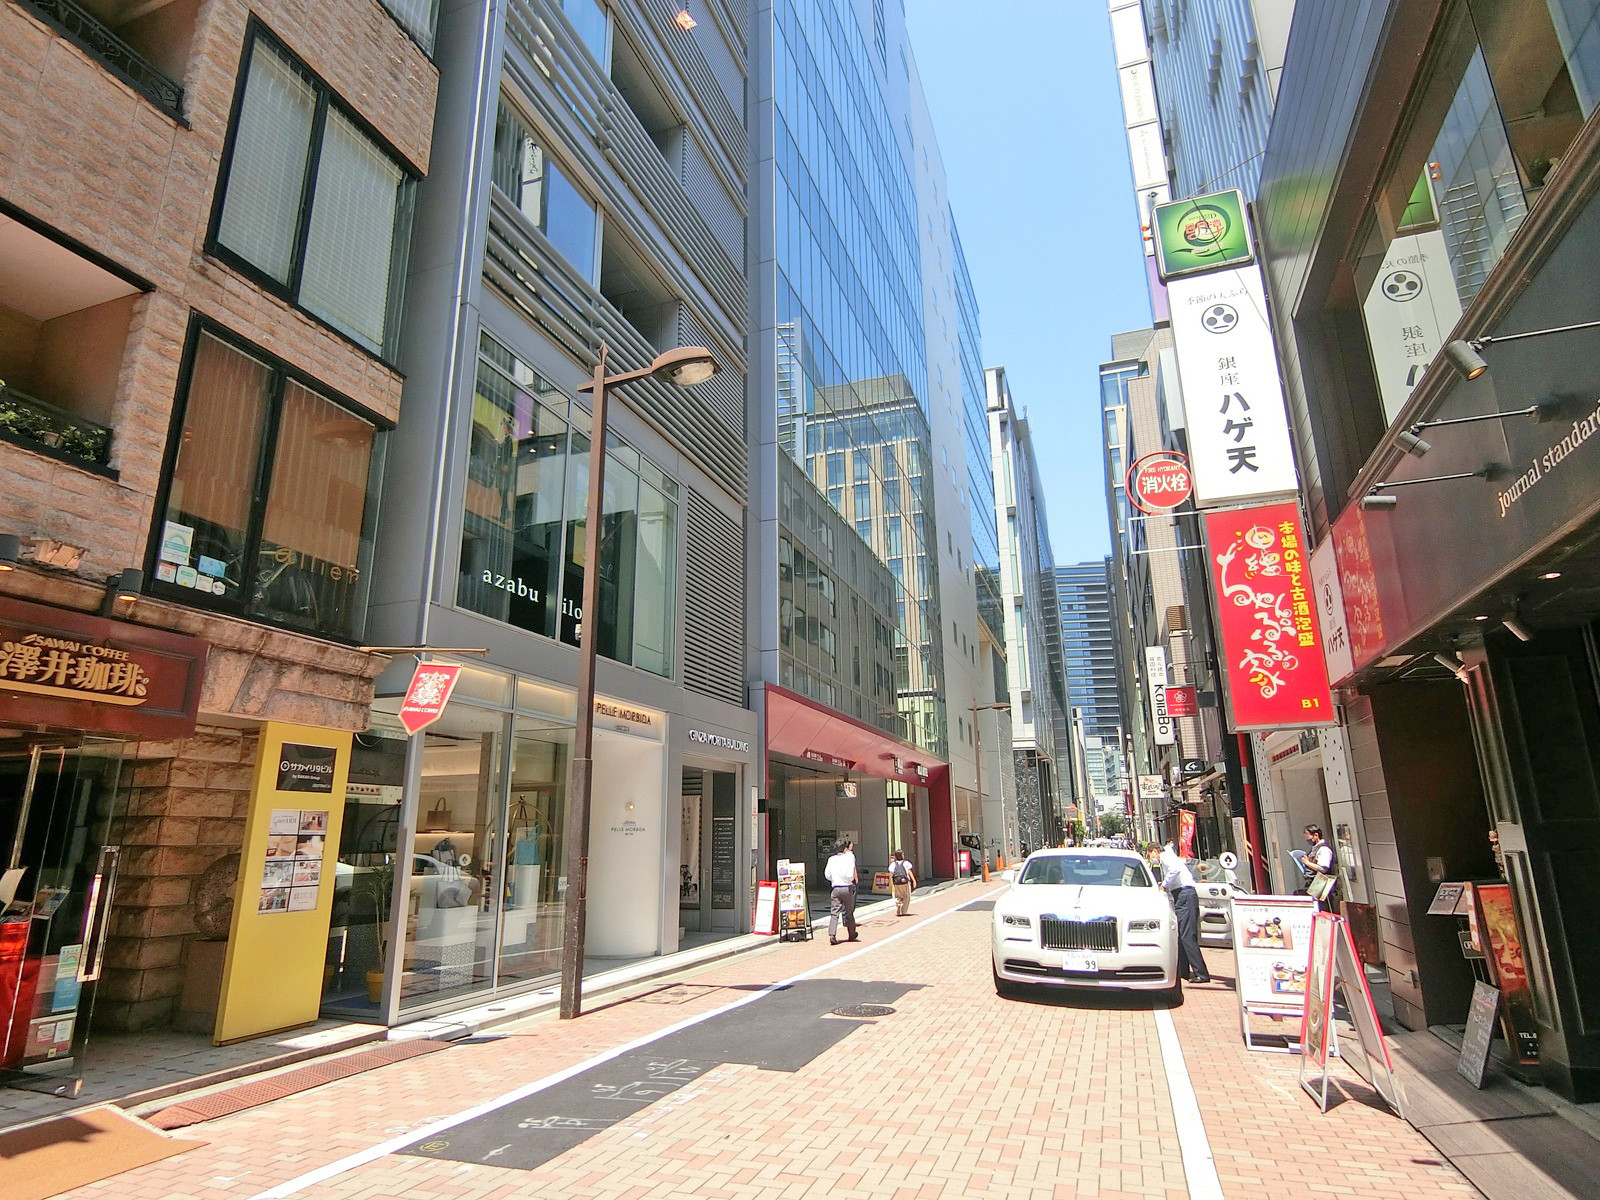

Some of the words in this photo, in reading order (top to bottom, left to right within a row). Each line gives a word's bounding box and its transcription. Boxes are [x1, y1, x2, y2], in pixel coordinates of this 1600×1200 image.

[1219, 391, 1259, 475] ハゲ天
[1158, 464, 1180, 472] HYDRANT
[1141, 473, 1188, 495] 消火栓
[1498, 458, 1542, 518] journal
[482, 569, 539, 603] azabu
[1278, 520, 1315, 647] 本場の味と古酒泡盛
[32, 635, 80, 652] SAWAI
[82, 644, 130, 660] COFFEE
[0, 641, 144, 696] 澤井珈琲
[596, 702, 618, 717] PELLE
[619, 709, 651, 725] MORBIDA
[1301, 698, 1320, 709] B1
